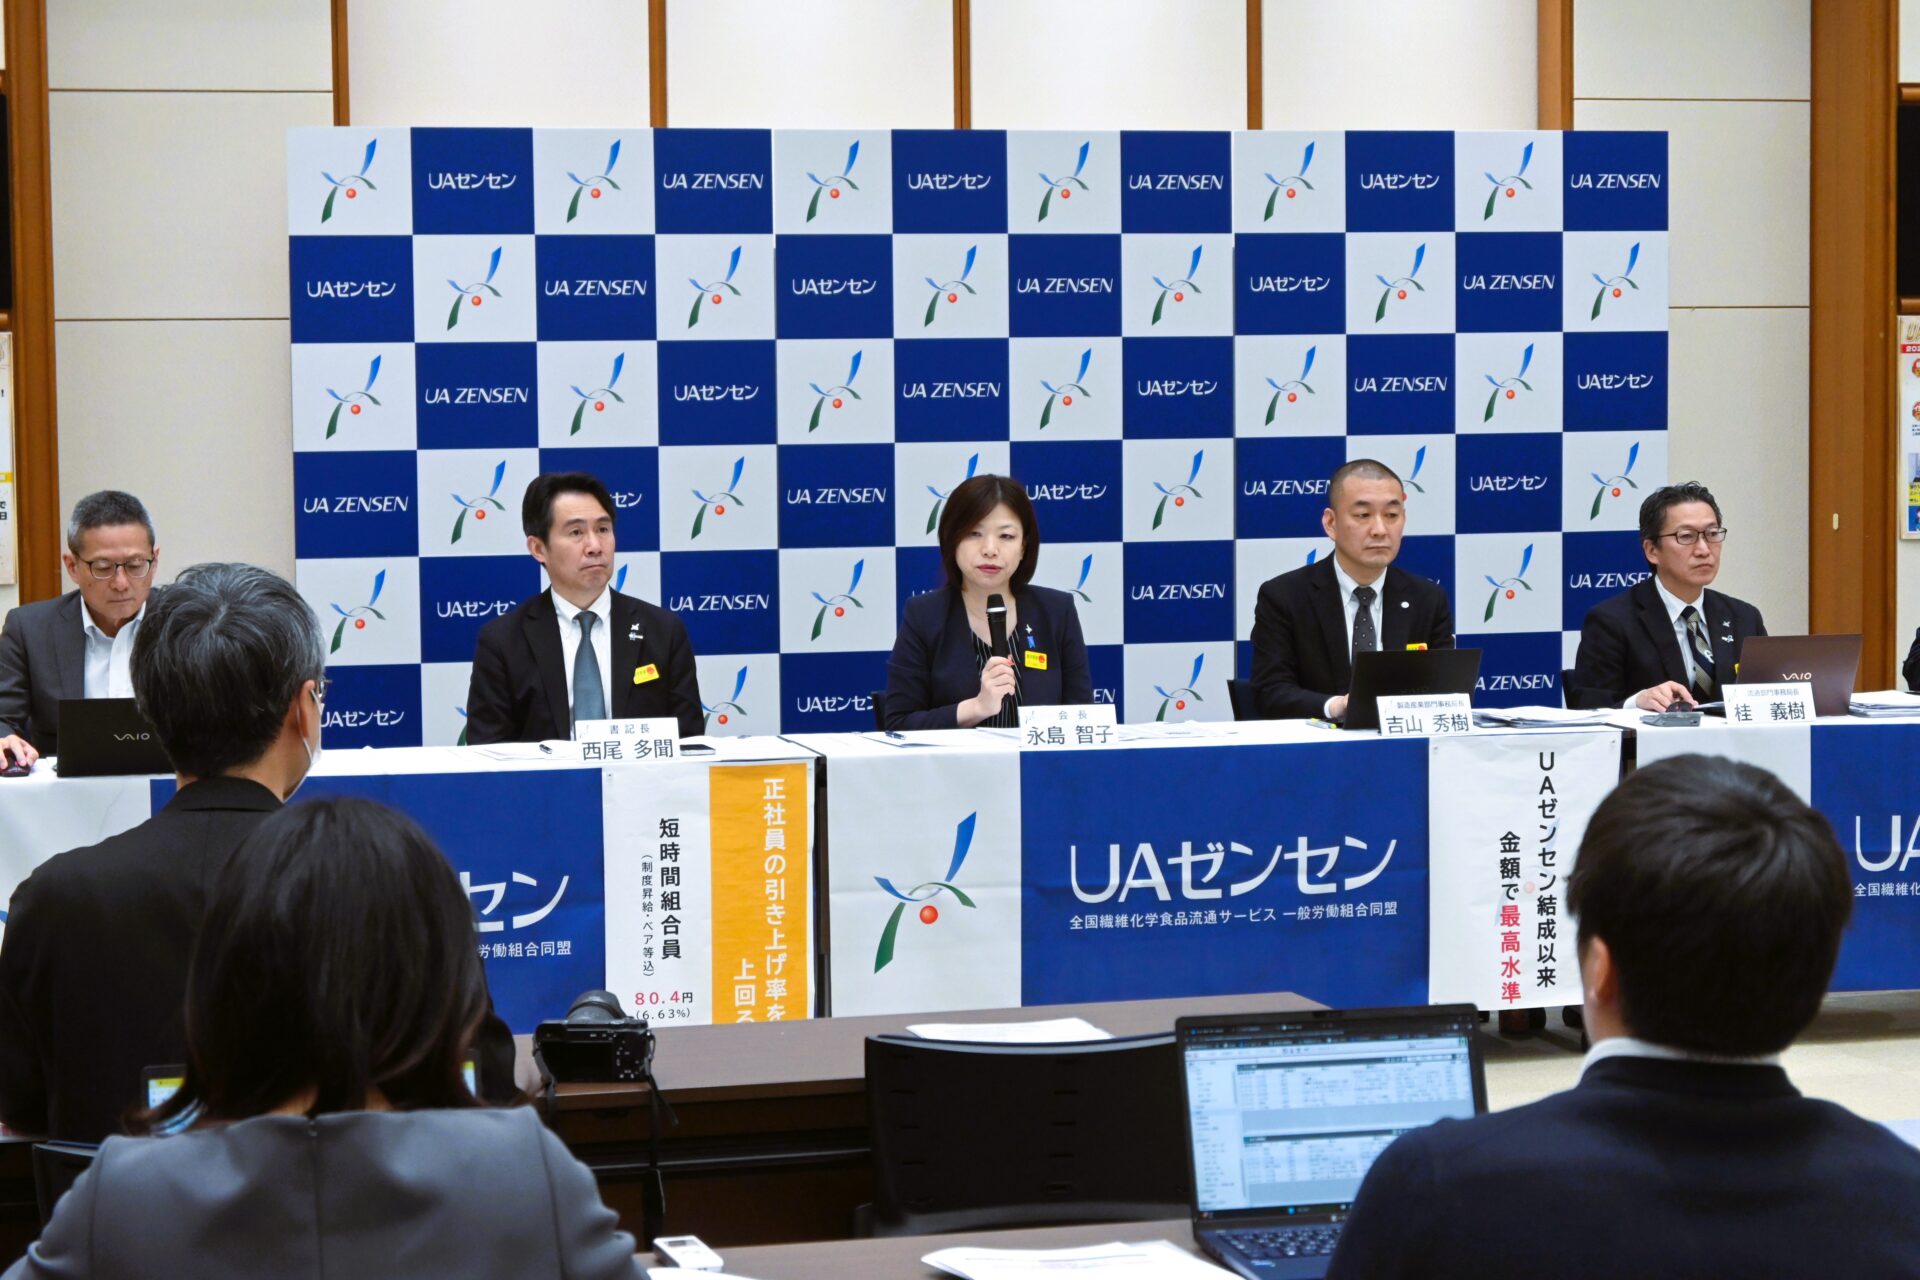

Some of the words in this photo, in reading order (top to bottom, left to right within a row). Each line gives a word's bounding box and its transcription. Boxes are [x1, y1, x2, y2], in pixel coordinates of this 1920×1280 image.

[428, 171, 517, 190] UAゼンセン
[663, 173, 688, 189] UA
[691, 172, 764, 189] ZENSEN
[908, 172, 991, 190] UAゼンセン
[1129, 174, 1153, 190] UA
[1155, 173, 1224, 190] ZENSEN
[1361, 172, 1440, 190] UAゼンセン
[1570, 173, 1593, 189] UA
[1596, 173, 1661, 189] ZENSEN
[307, 280, 396, 298] UAゼンセン
[544, 280, 570, 296] UA
[573, 279, 647, 296] ZENSEN
[792, 277, 877, 295] UAゼンセン
[1017, 278, 1041, 294] UA
[1044, 277, 1114, 294] ZENSEN
[1250, 275, 1330, 292] UAゼンセン
[1463, 275, 1486, 290] UA
[1489, 274, 1555, 290] ZENSEN
[1138, 379, 1218, 396] UAゼンセン
[1354, 377, 1377, 393] UA
[1380, 376, 1448, 393] ZENSEN
[1577, 372, 1654, 390] UAゼンセン
[425, 388, 451, 404] UA
[454, 387, 529, 404] ZENSEN
[674, 383, 759, 401] UAゼンセン
[903, 383, 927, 399] UA
[930, 382, 1001, 398] ZENSEN
[1244, 480, 1267, 496] UA
[1470, 474, 1548, 492] UAゼンセン
[787, 488, 812, 505] UA
[815, 487, 887, 504] ZENSEN
[1025, 484, 1107, 501] UAゼンセン
[303, 497, 330, 514] UA
[333, 496, 409, 513] ZENSEN
[1570, 573, 1592, 589] UA
[1595, 572, 1653, 588] ZENSE
[1131, 585, 1155, 601] UA
[1158, 583, 1226, 600] ZENSEN
[669, 596, 694, 612] UA
[697, 594, 769, 611] ZENSEN
[1489, 674, 1555, 691] ZENSEN
[1782, 672, 1812, 681] VAIO
[1734, 703, 1753, 722] 桂
[1770, 701, 1806, 721] 義樹
[1385, 715, 1423, 734] 吉山
[1432, 713, 1470, 733] 秀樹
[113, 732, 150, 741] VAIO
[1027, 726, 1065, 746] 永島
[1075, 725, 1113, 745] 智子
[581, 741, 624, 761] 西尾
[634, 738, 674, 760] 多聞
[1070, 835, 1398, 904] UAゼンセン
[1536, 751, 1557, 988] UAゼンセン結成以来
[658, 817, 682, 960] 短時間組合員
[763, 778, 788, 1022] 正社員の引き上げ率を
